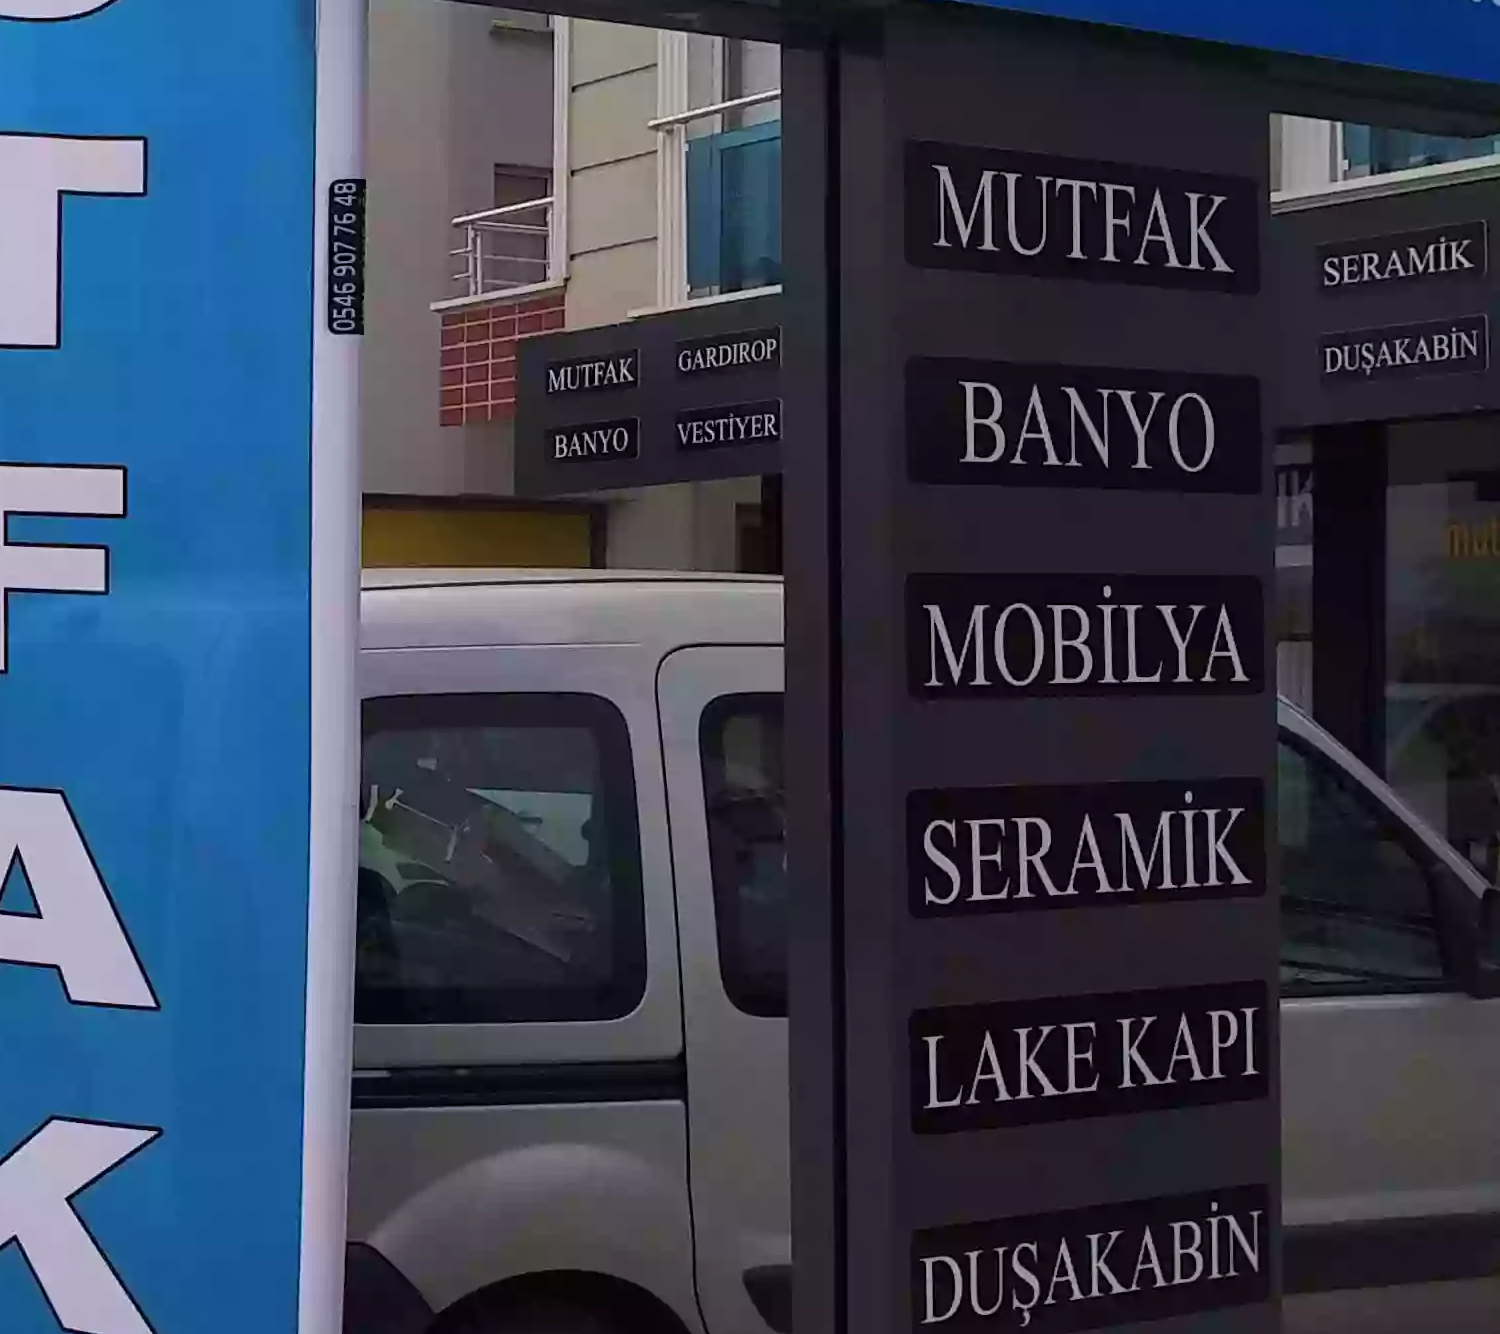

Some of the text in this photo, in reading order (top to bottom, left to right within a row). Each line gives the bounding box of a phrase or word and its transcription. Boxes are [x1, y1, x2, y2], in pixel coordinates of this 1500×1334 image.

[332, 182, 358, 332] 0546 907 76 48
[931, 164, 1234, 274] MUTFAK
[1323, 235, 1476, 287] SERAMİK
[547, 357, 636, 394] MUTFAK
[677, 338, 778, 373] GARDIROP
[1323, 326, 1479, 376] DUŞAKABİN
[553, 427, 629, 459] BANYO
[675, 412, 779, 446] VESTİYER
[958, 380, 1218, 474] BANYO
[922, 584, 1251, 687] MOBİLYA
[922, 790, 1254, 906] SERAMİK
[921, 1006, 1261, 1111] LAKE KAPI
[918, 1200, 1264, 1327] DUŞAKABİN
